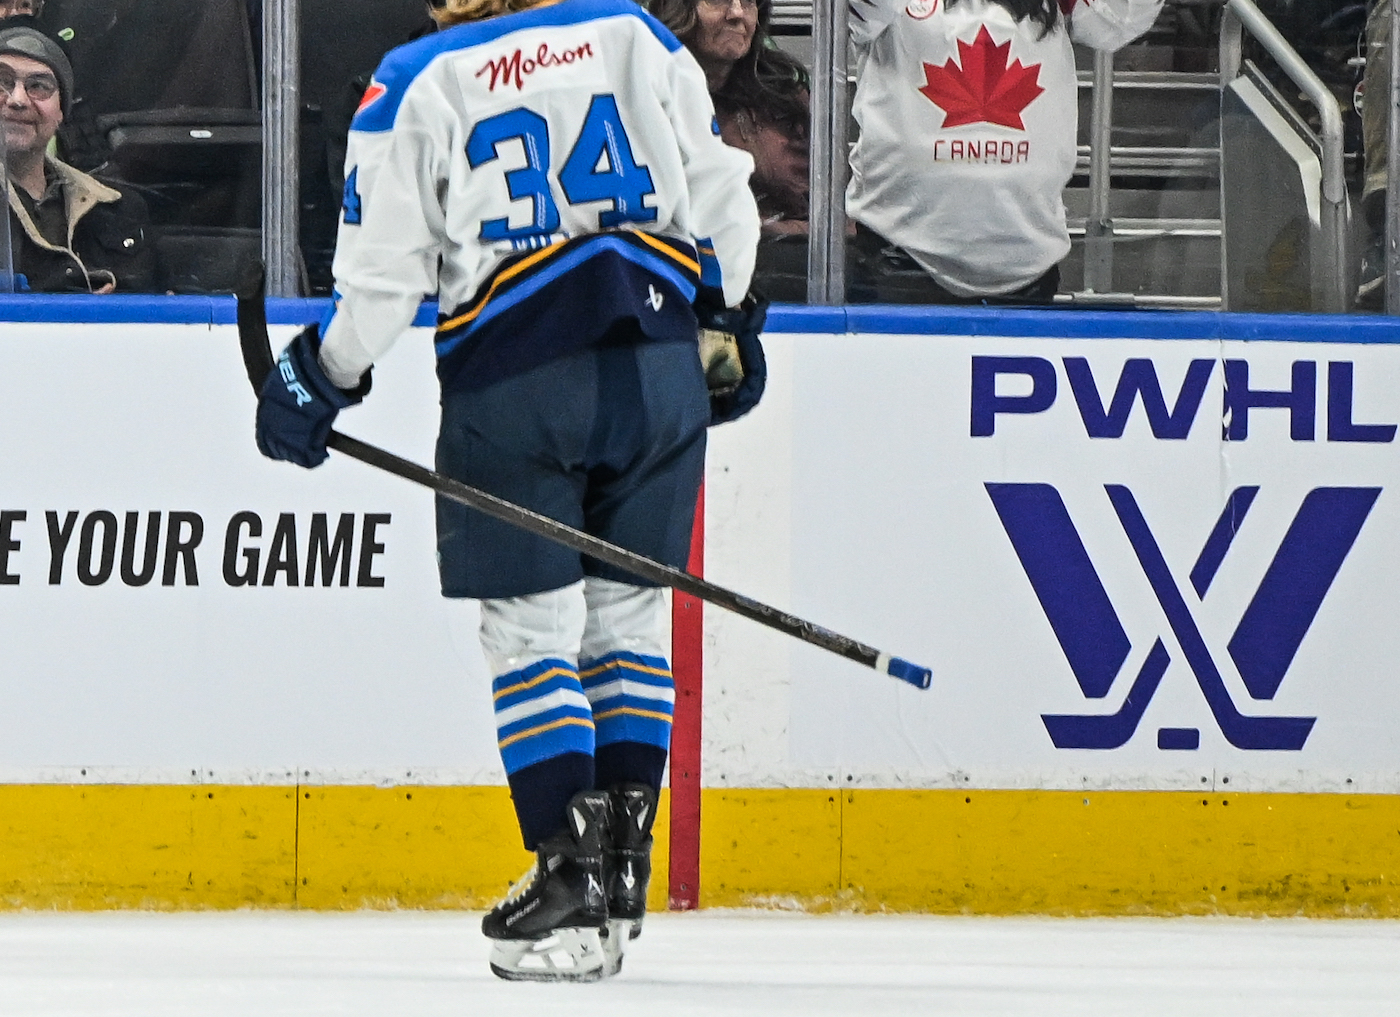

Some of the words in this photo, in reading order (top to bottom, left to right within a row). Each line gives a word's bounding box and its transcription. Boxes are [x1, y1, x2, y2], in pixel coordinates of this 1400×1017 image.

[475, 42, 594, 91] Molson
[465, 93, 659, 242] 34
[933, 140, 1030, 165] CANADA
[971, 356, 1397, 442] PWHL
[46, 511, 203, 586] YOUR
[223, 511, 391, 587] GAME
